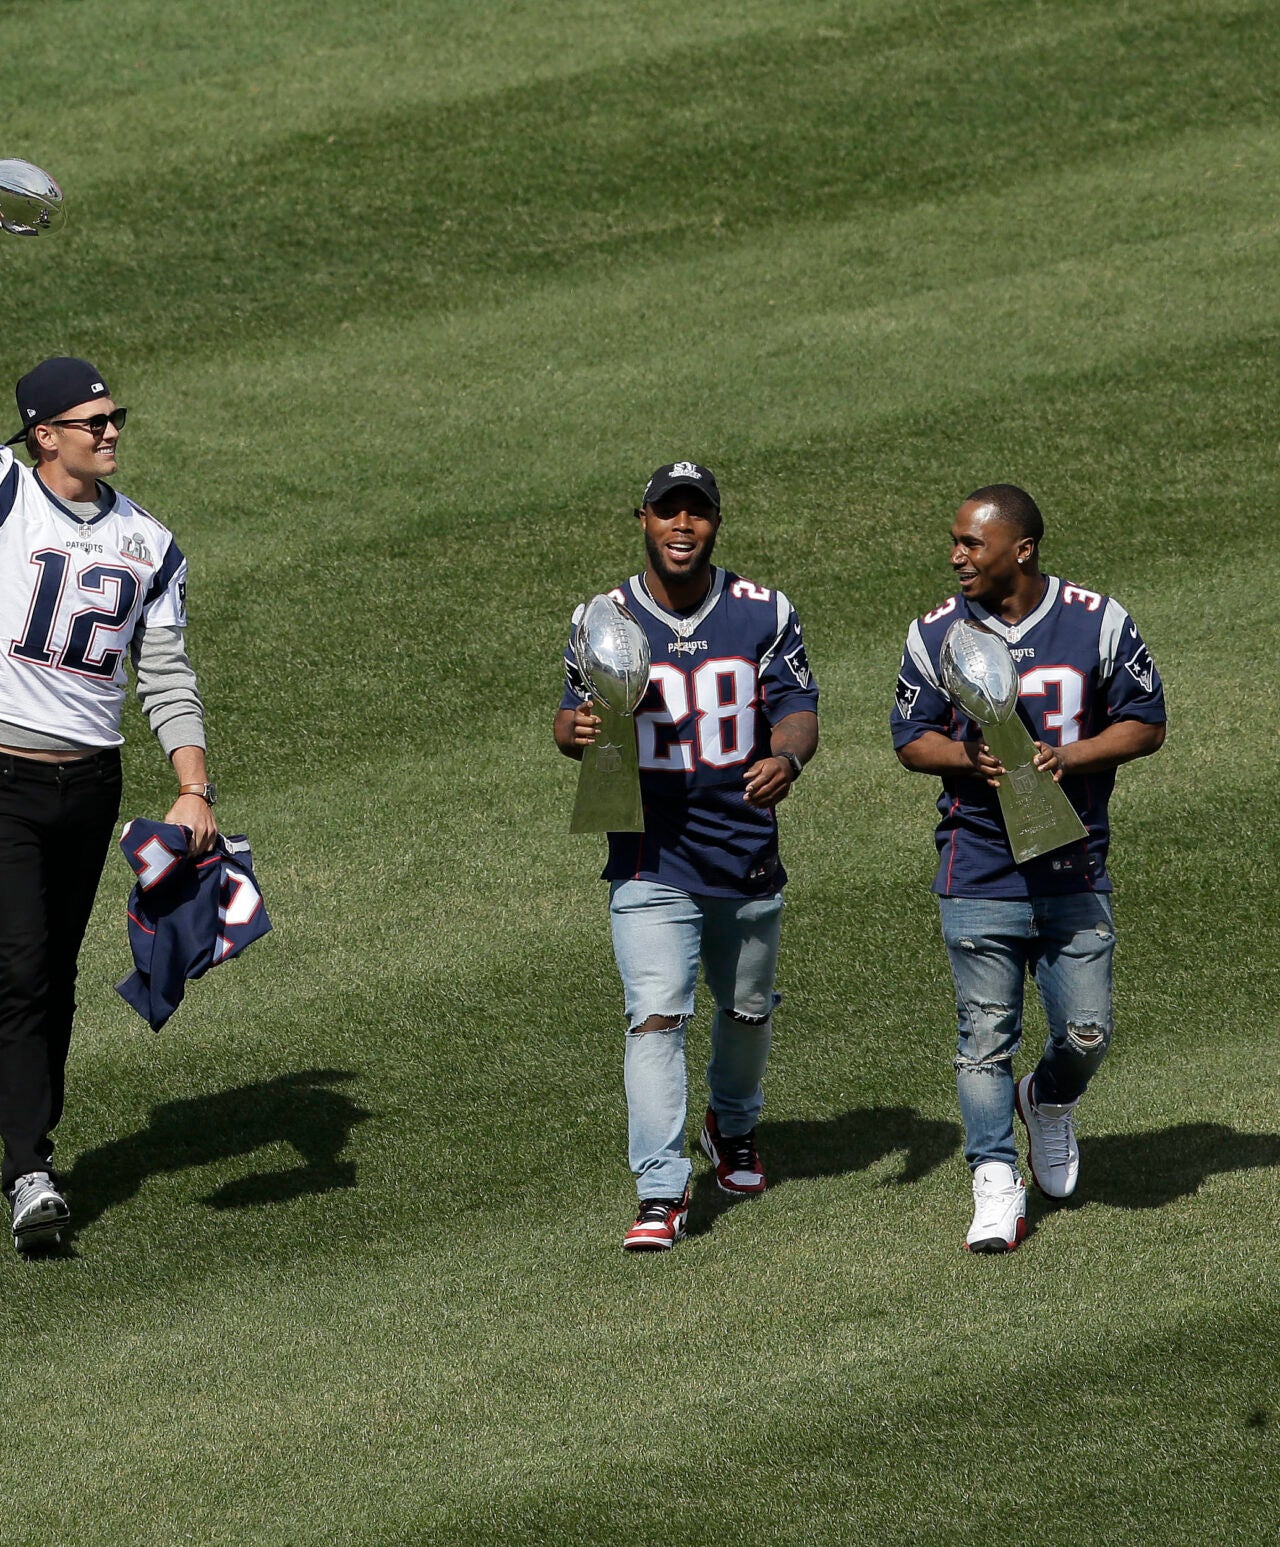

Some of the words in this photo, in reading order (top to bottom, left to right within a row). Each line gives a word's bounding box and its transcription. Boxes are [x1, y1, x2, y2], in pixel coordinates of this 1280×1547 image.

[65, 541, 104, 553] PATRIOTS
[8, 547, 140, 681] 12
[633, 655, 759, 773] 28
